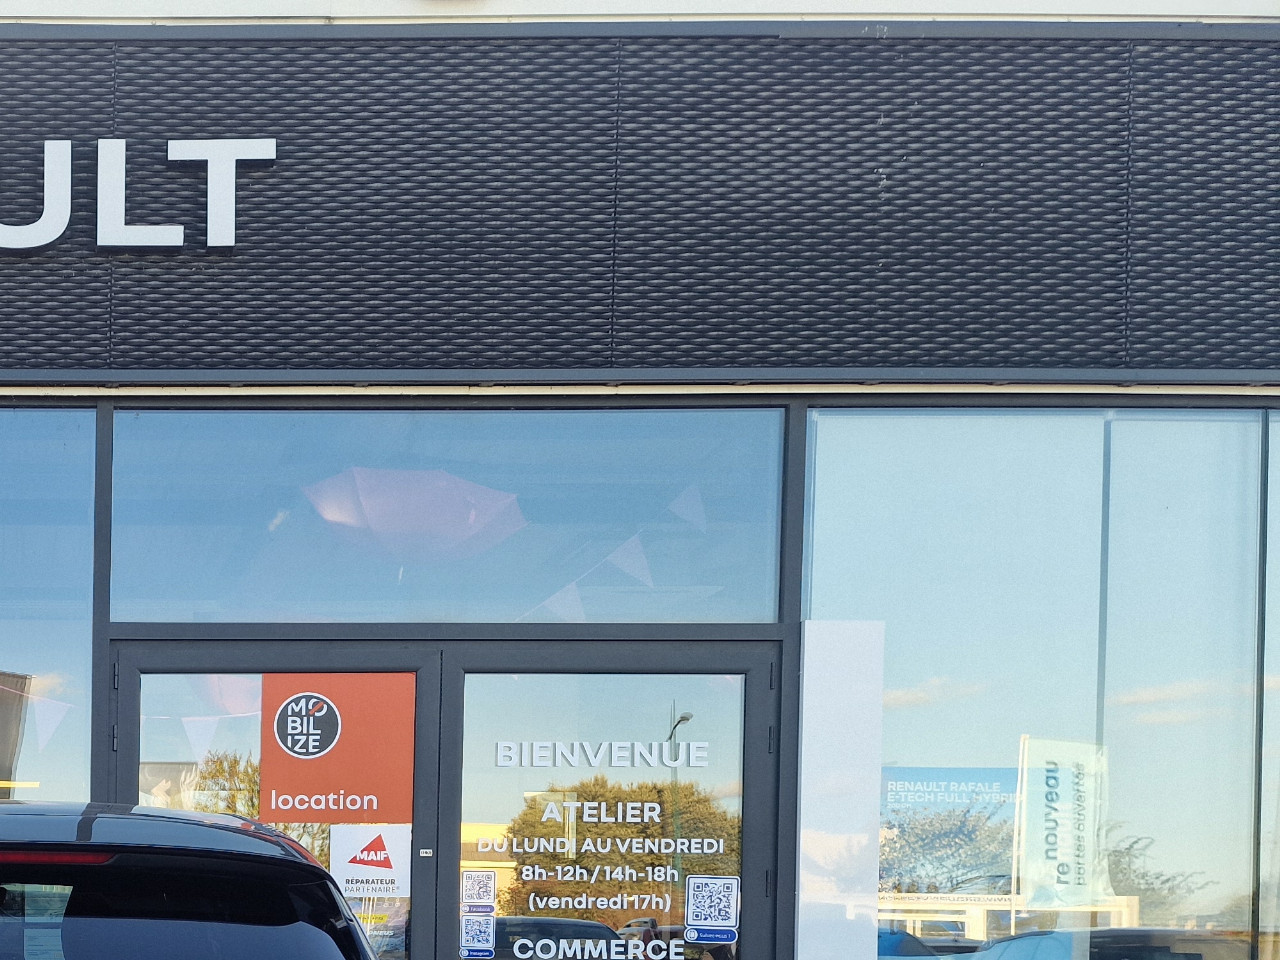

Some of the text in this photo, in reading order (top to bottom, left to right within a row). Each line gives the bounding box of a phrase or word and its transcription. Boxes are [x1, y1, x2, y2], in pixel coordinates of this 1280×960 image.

[495, 741, 710, 768] BIENVENUE
[887, 781, 1001, 792] RENAULT RAFALE
[271, 790, 378, 810] location
[887, 792, 935, 803] E-TECH
[937, 792, 971, 803] FULL
[540, 802, 662, 823] ATELIER
[1044, 760, 1059, 861] nouveau
[477, 838, 724, 854] DU LUNDI AU VENDREDI
[356, 850, 389, 861] MAIF
[345, 877, 396, 885] RÉPARATEUR
[521, 865, 588, 882] 8h-12h
[604, 866, 679, 882] 14h-18h
[528, 892, 672, 913] (vendredi 17h)
[512, 938, 685, 960] COMMERCE
